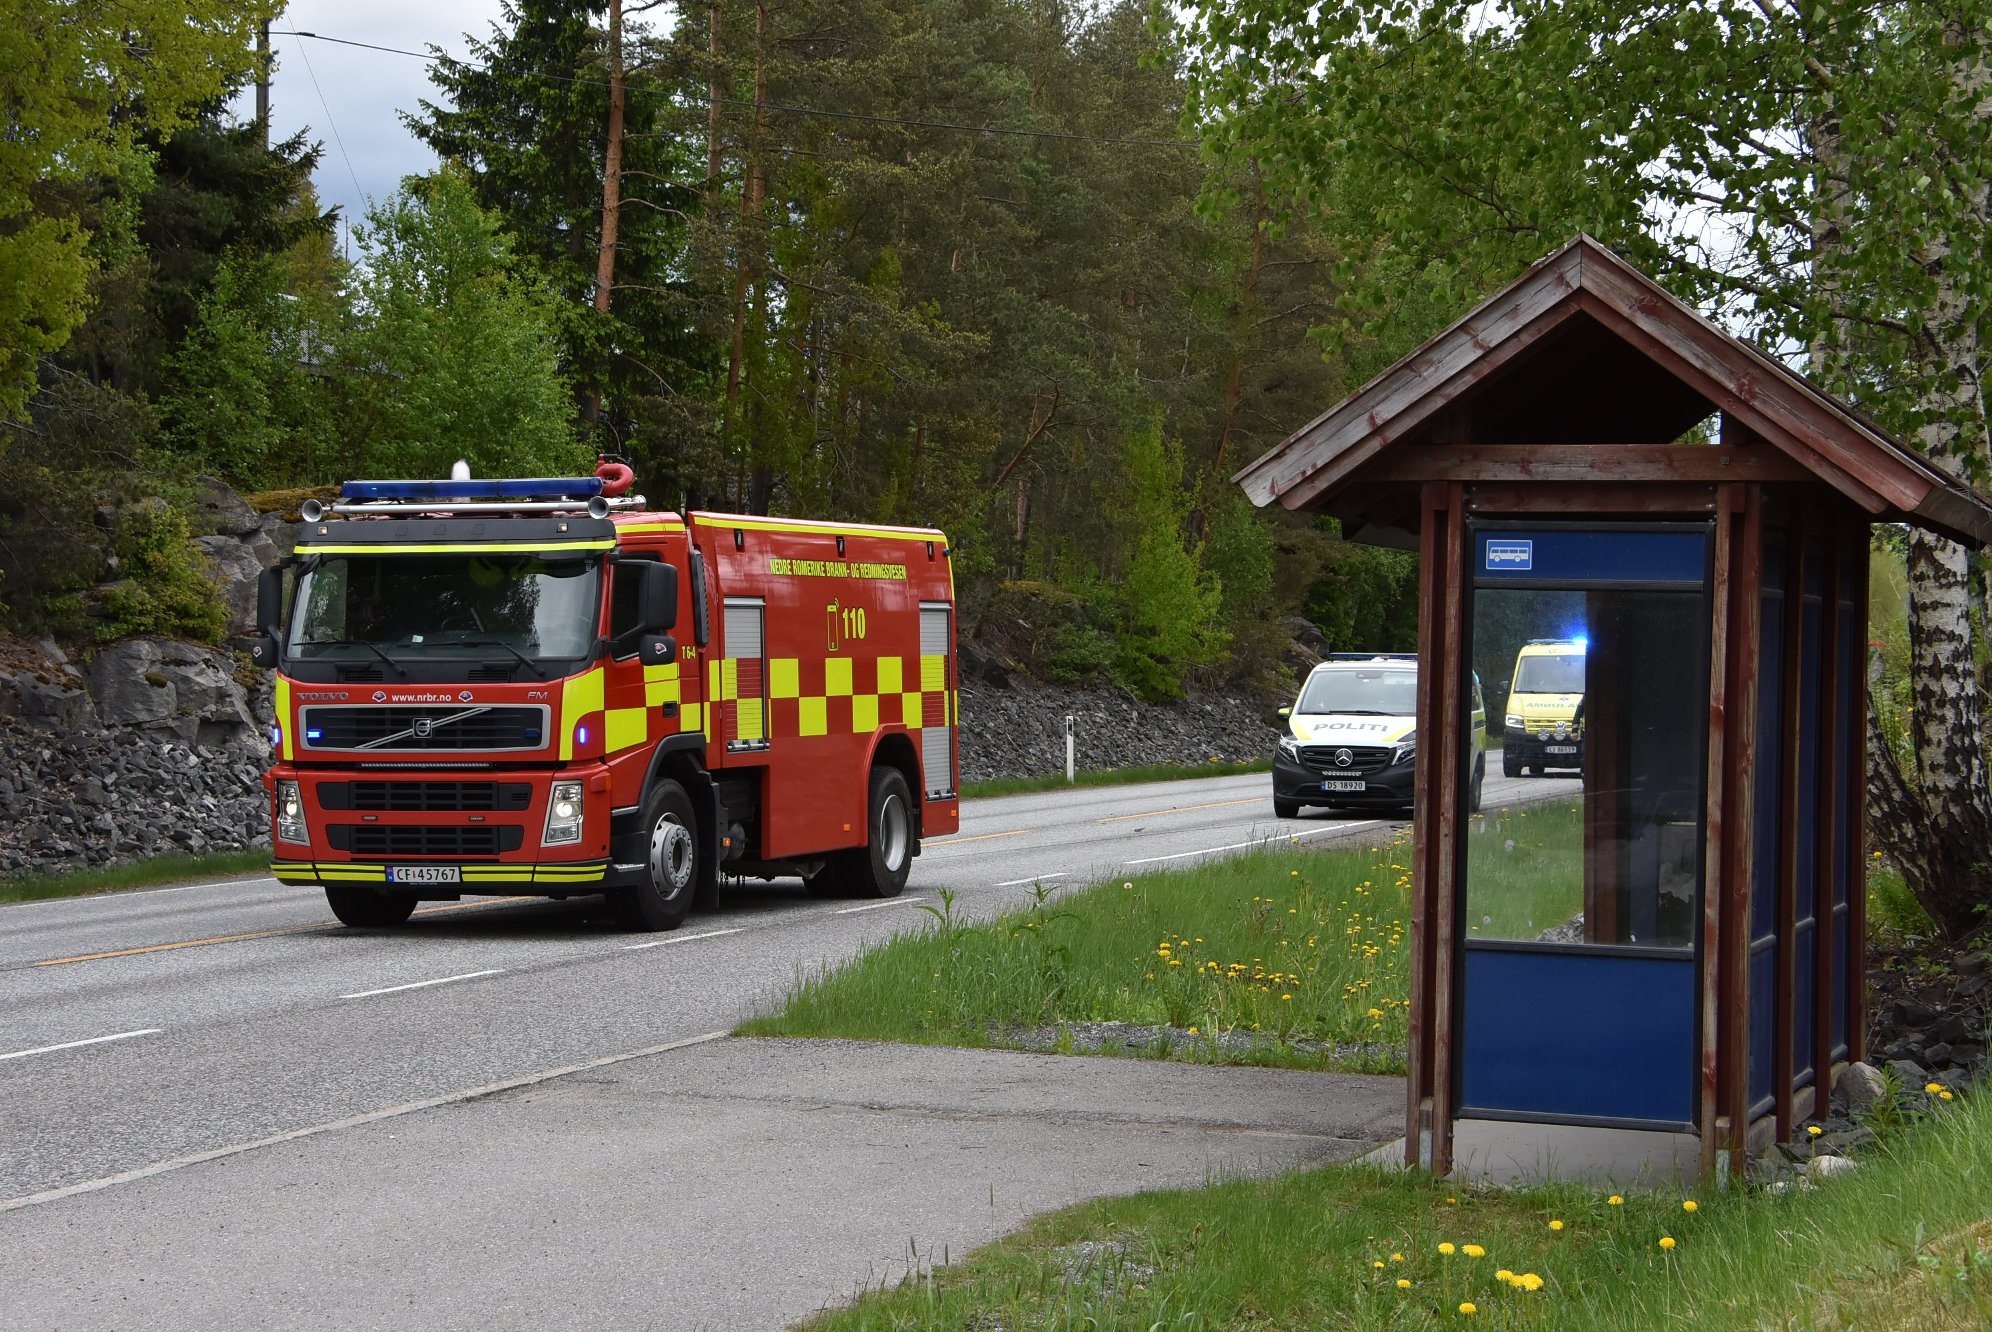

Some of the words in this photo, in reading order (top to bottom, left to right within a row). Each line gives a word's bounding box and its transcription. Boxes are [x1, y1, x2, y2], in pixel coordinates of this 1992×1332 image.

[770, 559, 792, 575] NEDRE
[793, 560, 825, 577] ROMERIKE
[826, 561, 850, 578] BRANN-
[851, 562, 859, 578] OG
[860, 563, 907, 579] REDNINGSVESEN
[842, 607, 866, 639] 110
[297, 692, 349, 700] VOLVO
[391, 693, 452, 702] www.nrbr.no
[527, 691, 548, 700] FM
[1313, 722, 1389, 732] POLITI
[1327, 781, 1337, 789] DS
[1340, 781, 1363, 790] 18920
[396, 868, 411, 880] CF
[417, 868, 456, 881] 45767
